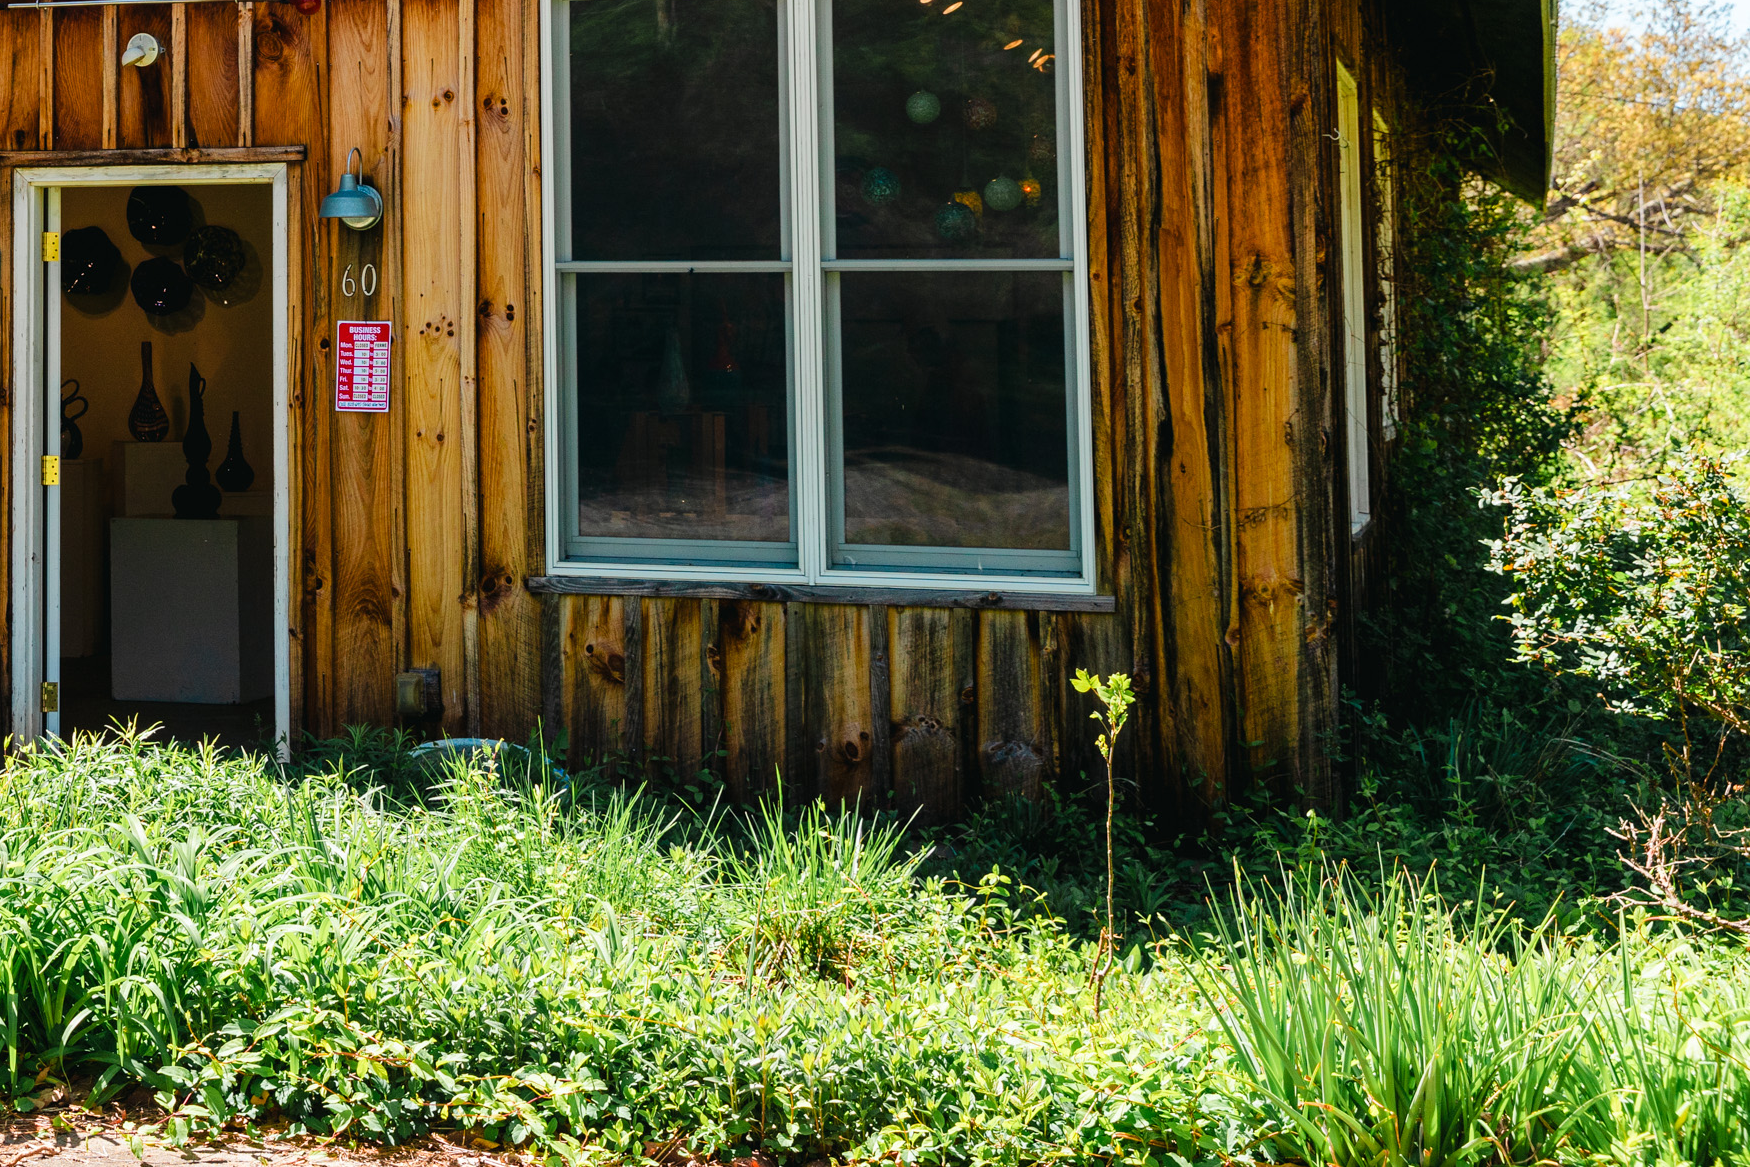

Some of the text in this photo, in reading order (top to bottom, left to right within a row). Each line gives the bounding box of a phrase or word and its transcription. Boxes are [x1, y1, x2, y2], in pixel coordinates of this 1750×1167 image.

[342, 264, 377, 296] 60
[349, 326, 381, 334] BUSINESS
[353, 333, 377, 341] HOURS:
